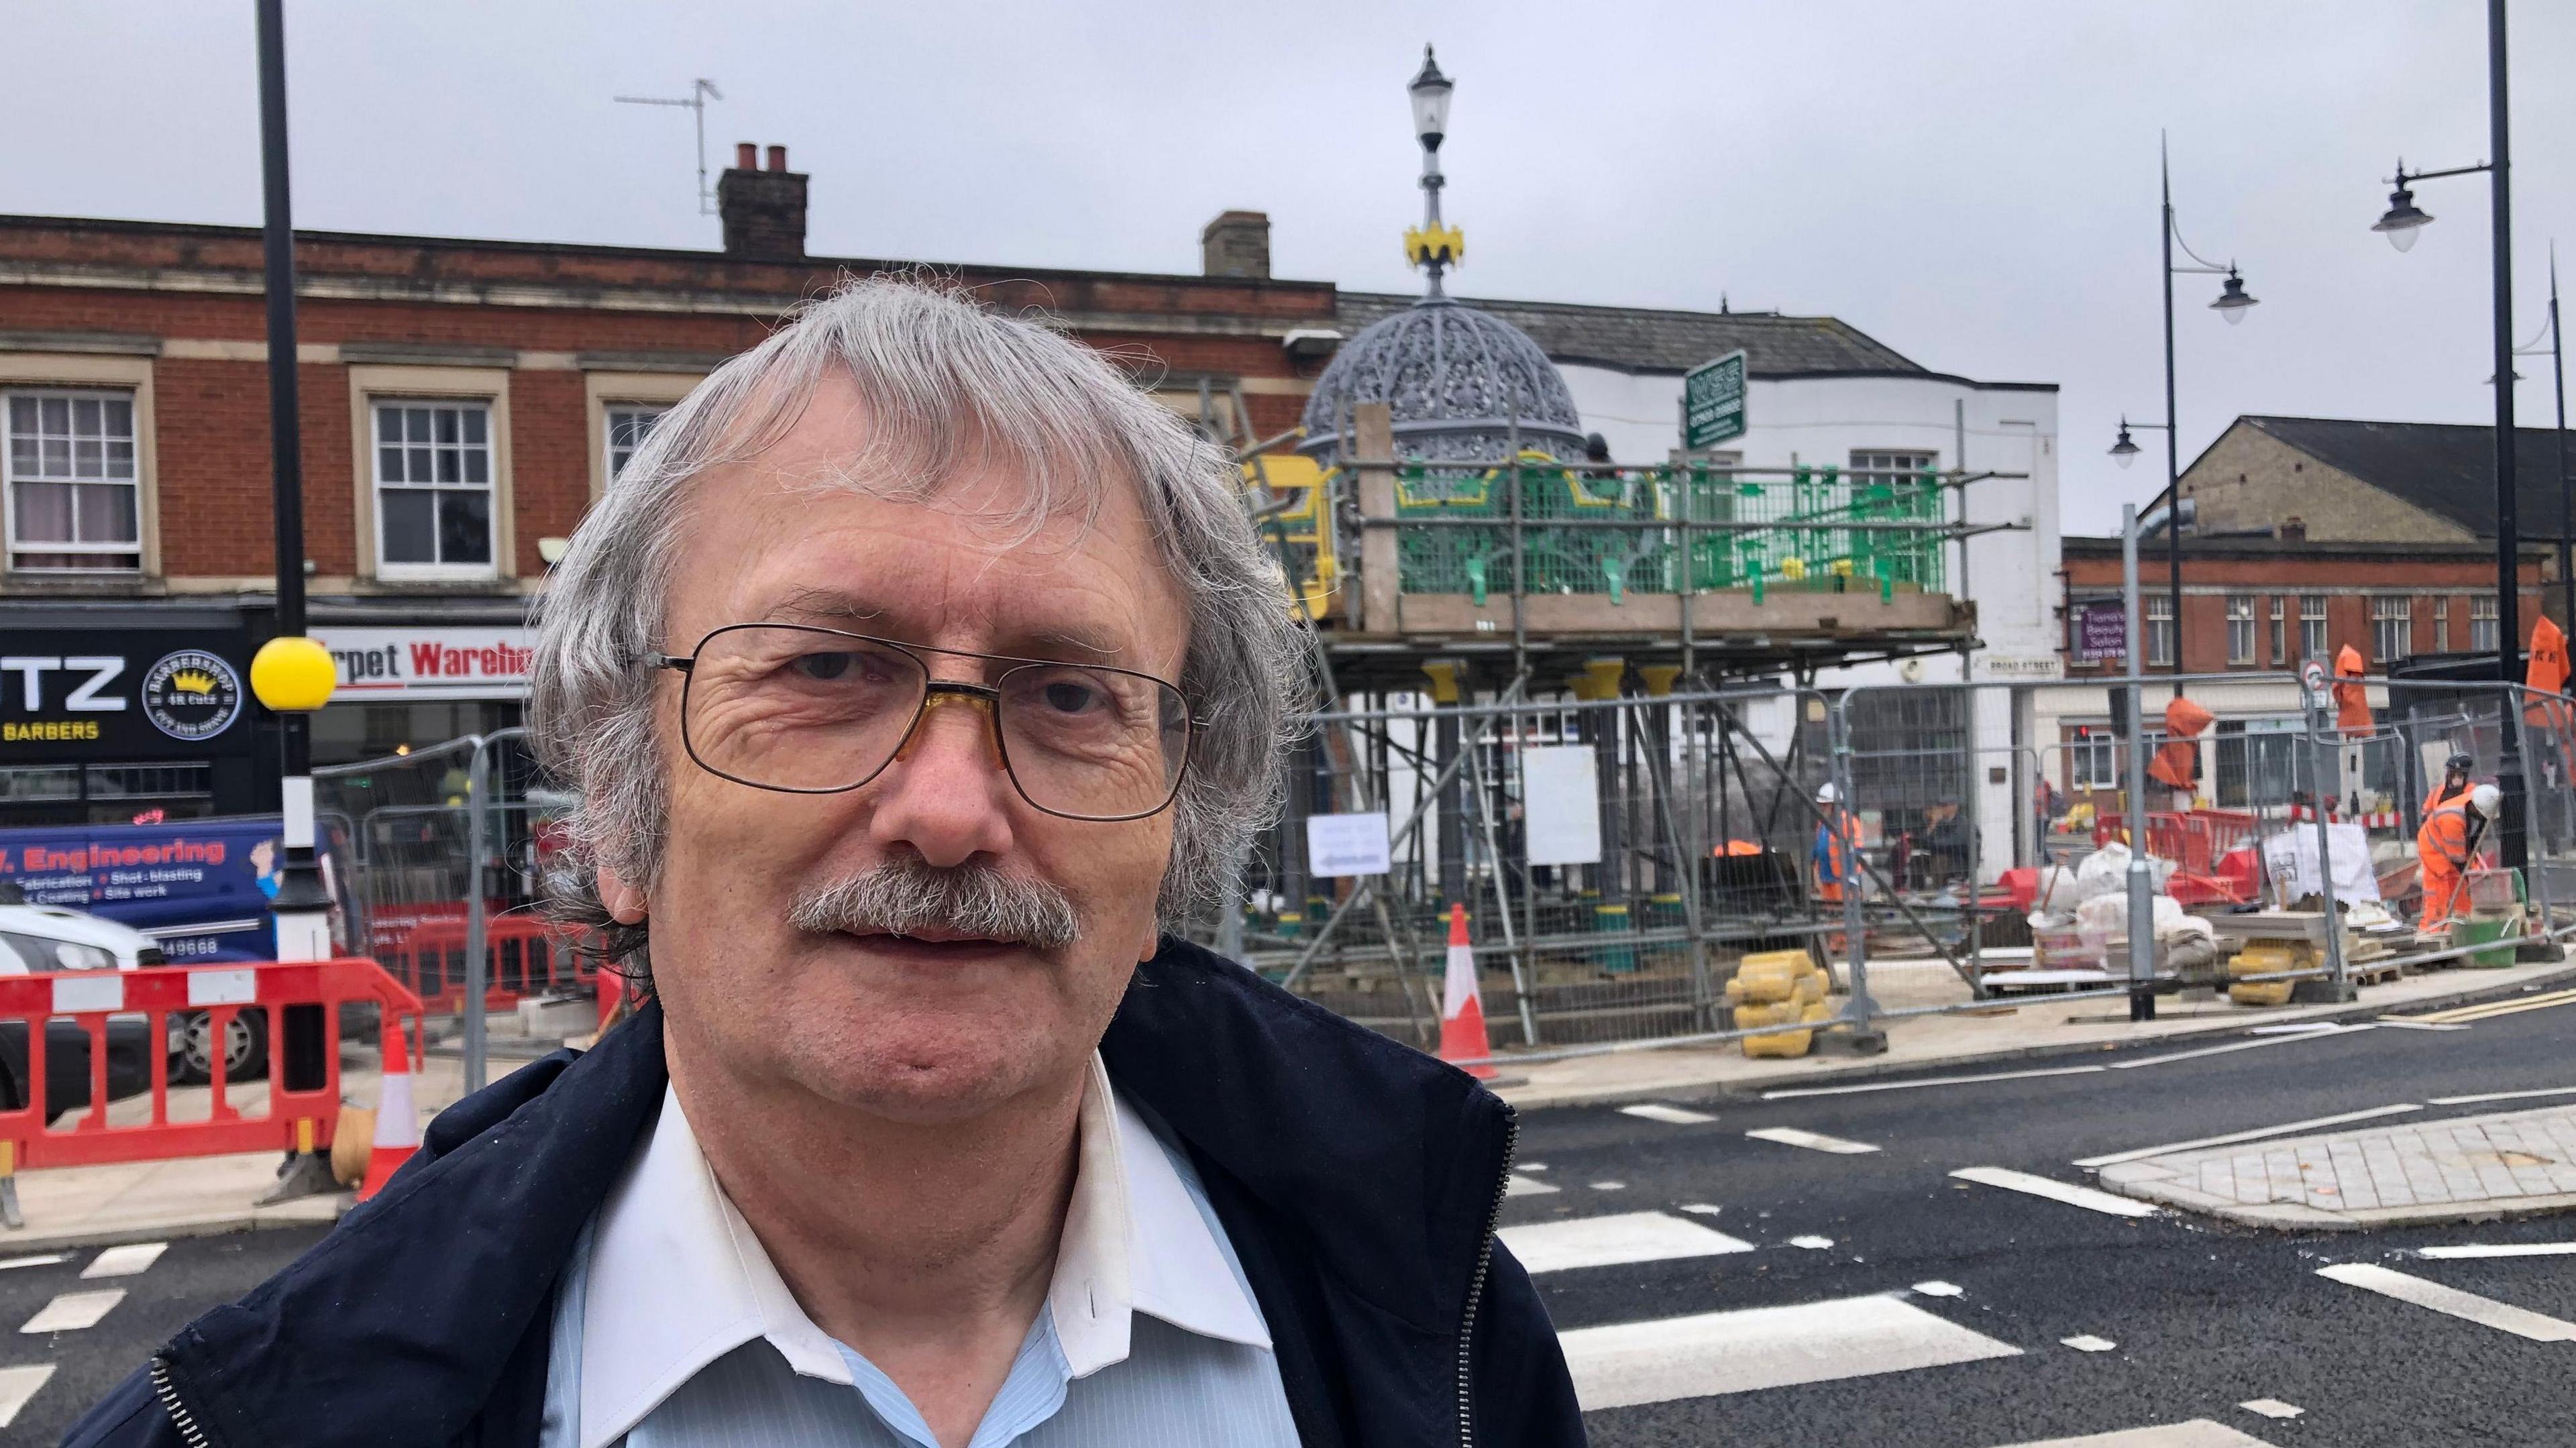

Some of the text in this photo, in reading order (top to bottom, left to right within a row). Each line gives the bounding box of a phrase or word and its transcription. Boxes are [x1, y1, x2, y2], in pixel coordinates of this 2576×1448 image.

[2090, 635, 2122, 647] Salon
[329, 640, 535, 685] rpet Wareho
[1990, 661, 2055, 671] BROAD STREET
[148, 655, 235, 693] BARBERSHOP
[3, 721, 99, 741] BARBERS
[24, 838, 226, 873] Engineering
[110, 869, 203, 885] Shot-blasting
[104, 886, 131, 900] Site
[134, 884, 168, 898] work
[160, 938, 218, 956] 49668
